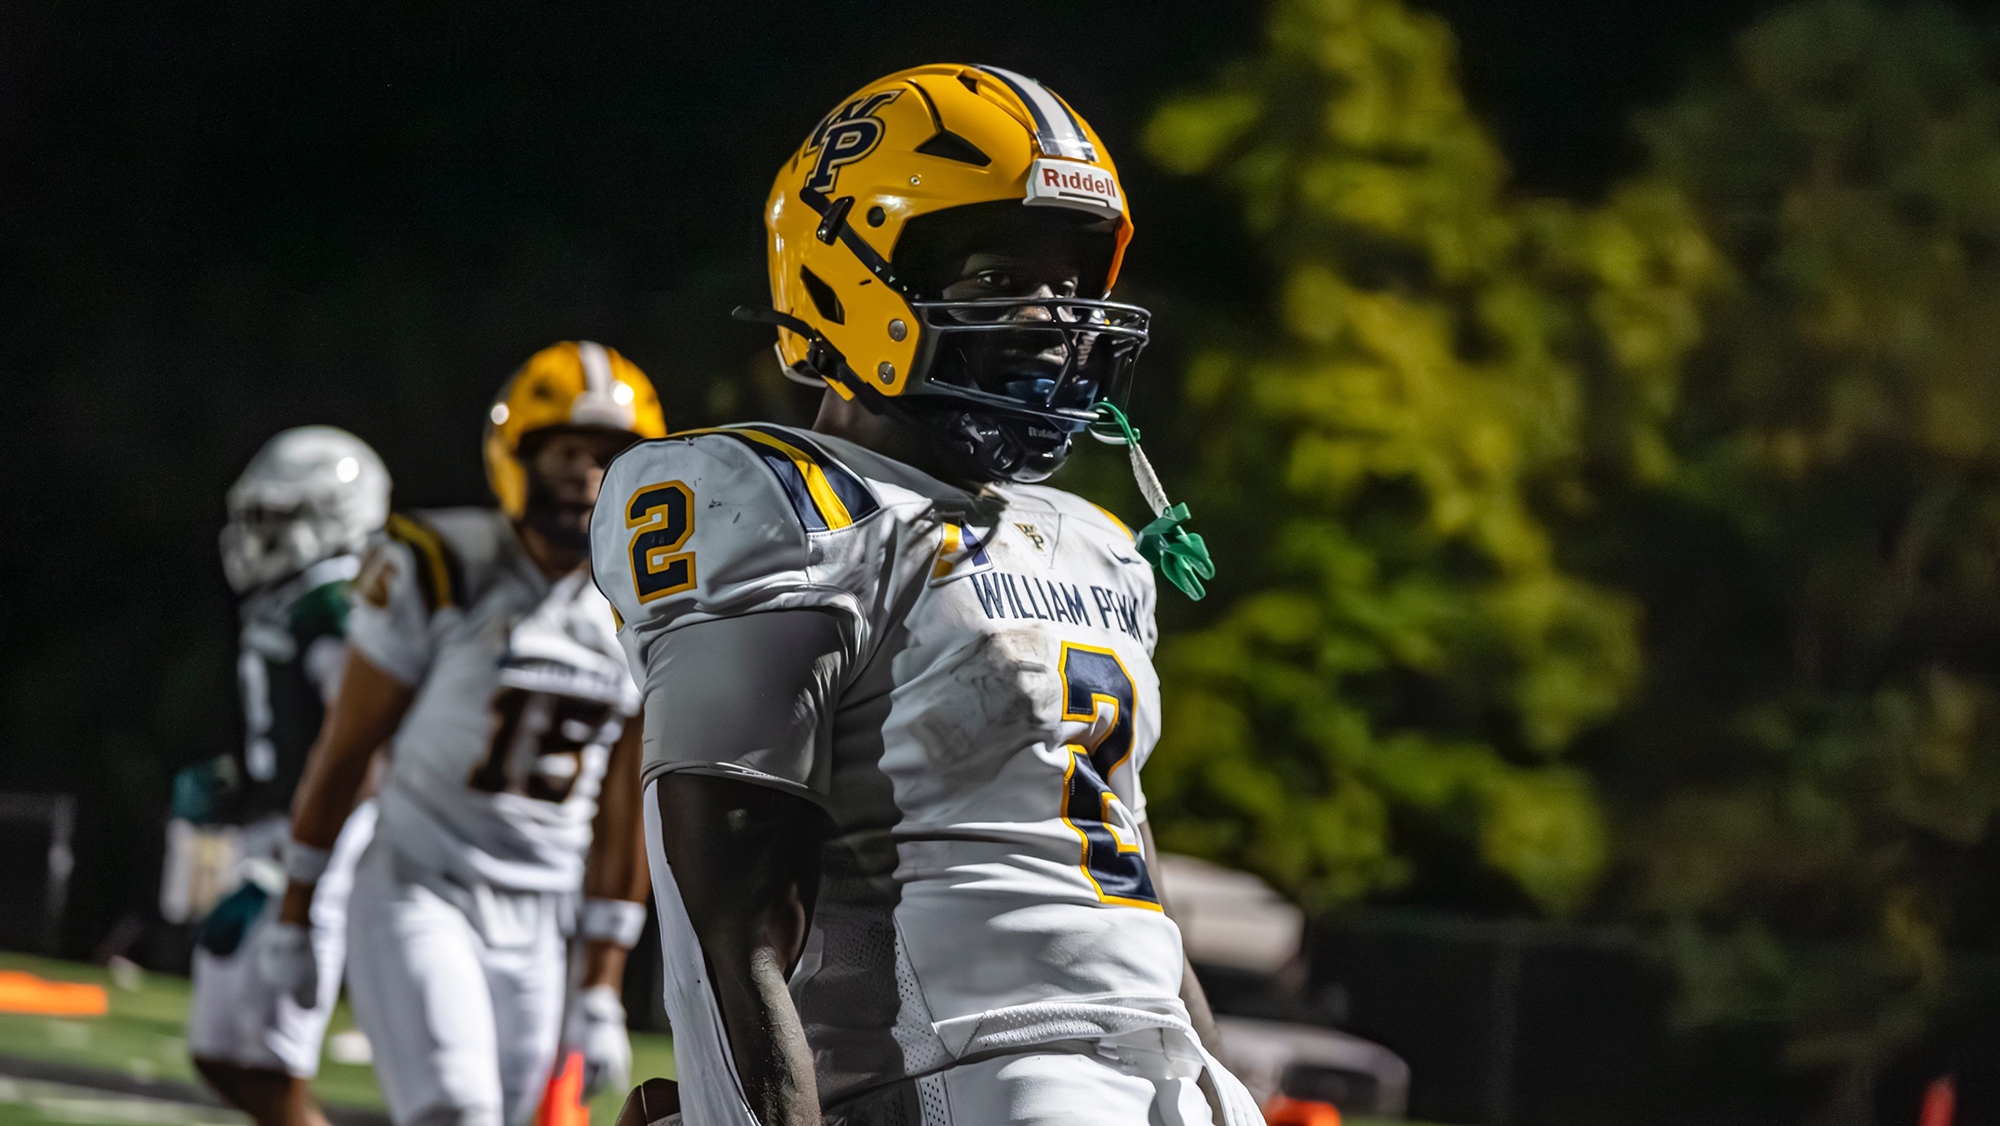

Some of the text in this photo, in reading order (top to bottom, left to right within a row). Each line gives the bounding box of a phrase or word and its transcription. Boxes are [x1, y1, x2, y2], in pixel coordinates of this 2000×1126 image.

[1042, 168, 1116, 198] Riddell
[625, 480, 697, 604] 2
[970, 572, 1092, 627] WILLIAM
[1058, 640, 1164, 913] 2
